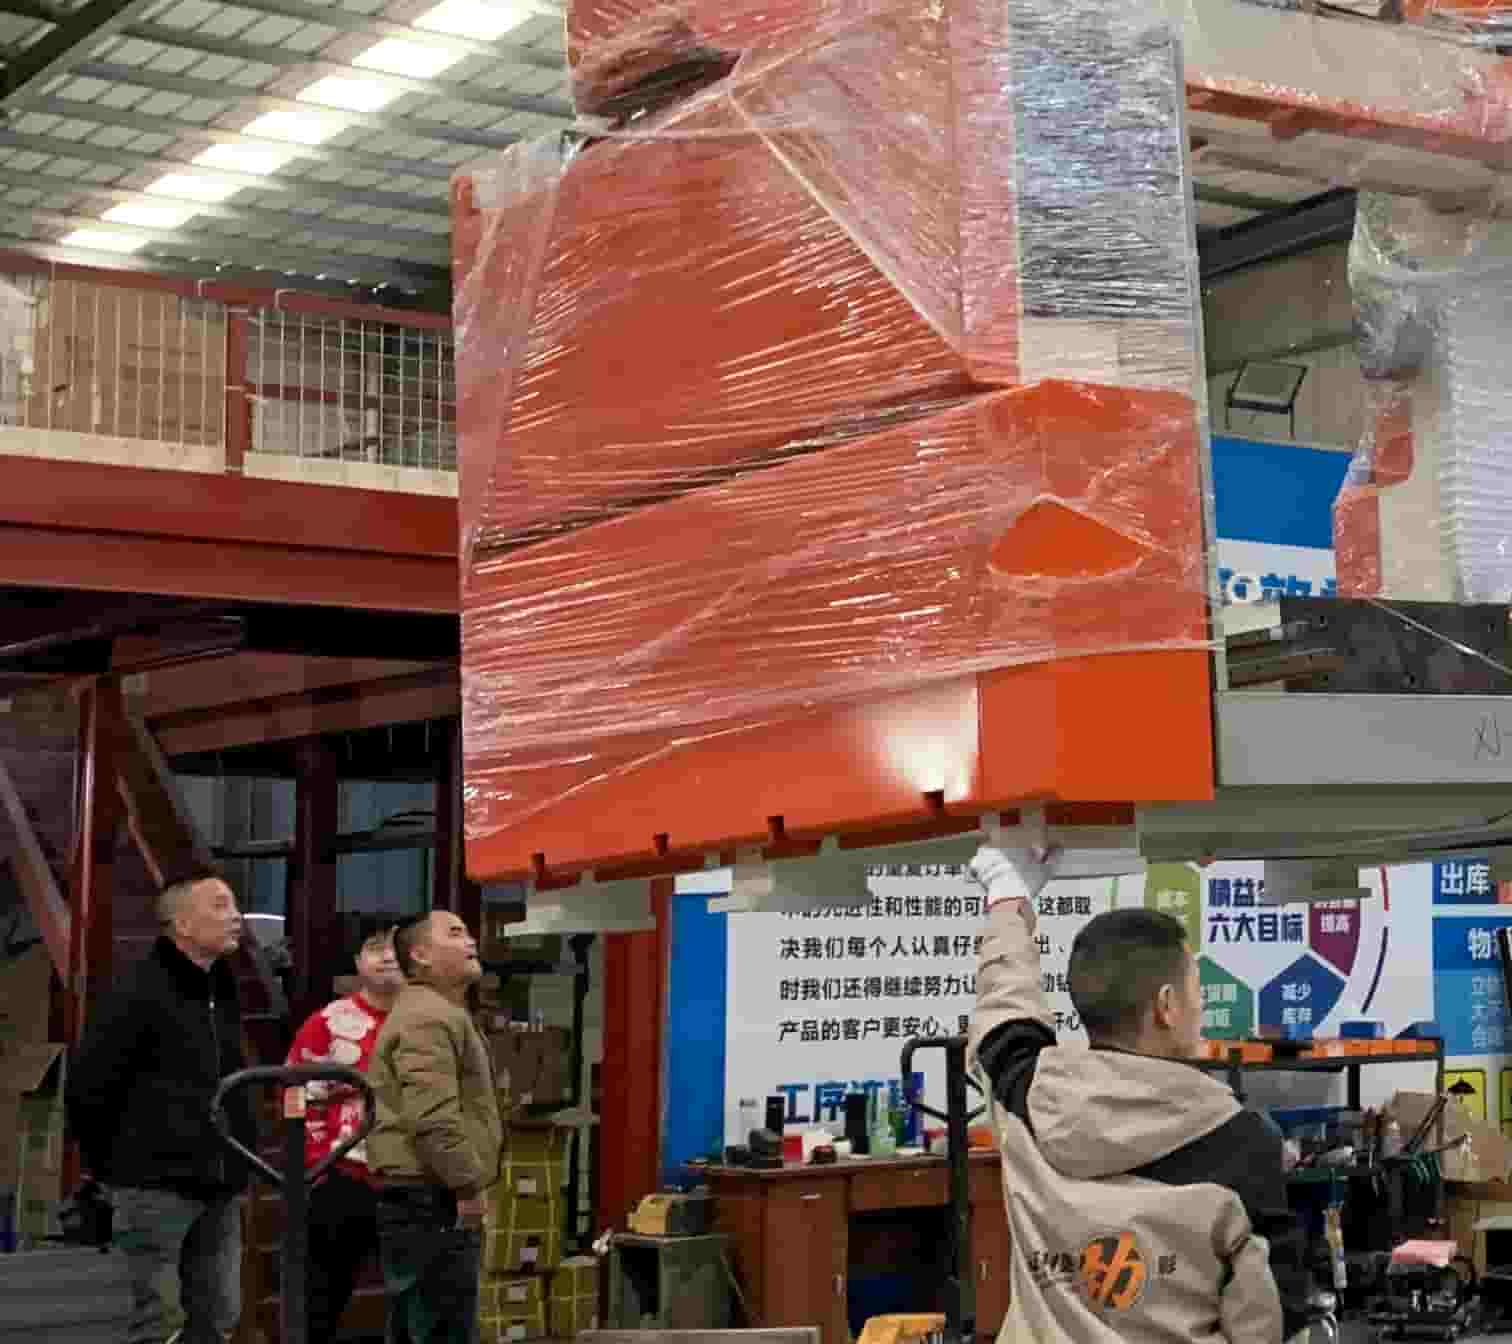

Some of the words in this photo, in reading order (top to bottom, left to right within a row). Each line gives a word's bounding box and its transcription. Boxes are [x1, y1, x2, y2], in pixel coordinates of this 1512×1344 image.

[1440, 862, 1493, 896] 出库
[1207, 912, 1305, 943] 六大目标
[1281, 982, 1313, 1002] 减少
